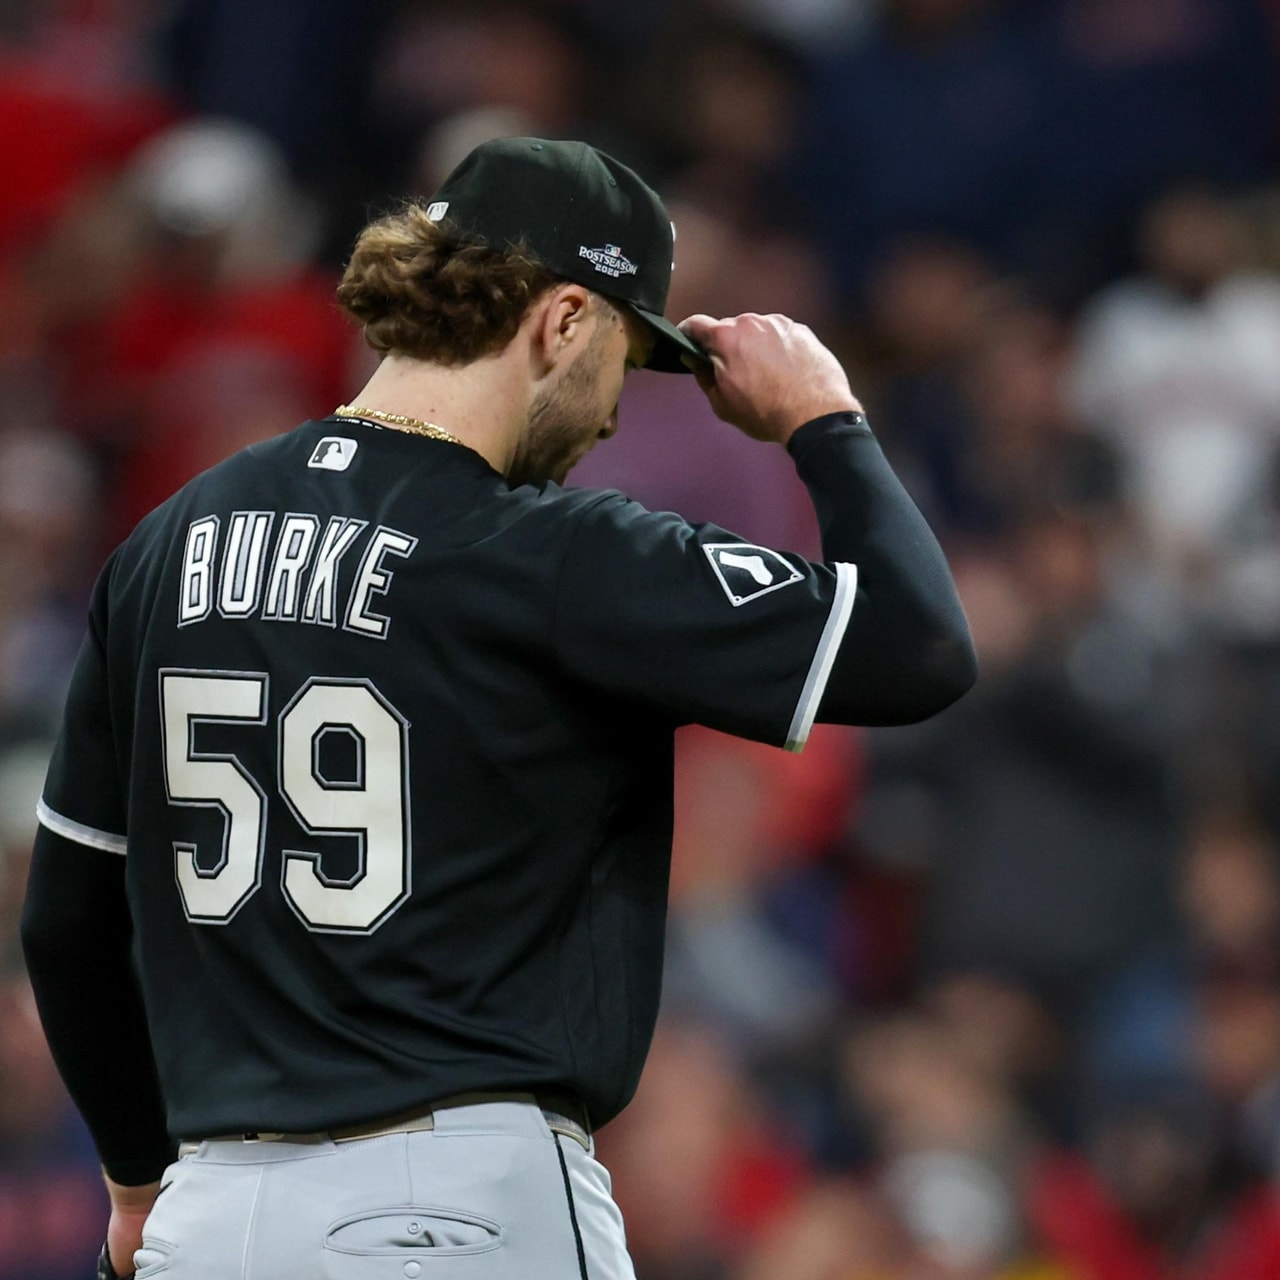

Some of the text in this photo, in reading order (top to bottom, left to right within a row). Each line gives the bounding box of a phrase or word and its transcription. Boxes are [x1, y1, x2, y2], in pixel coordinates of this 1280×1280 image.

[578, 245, 638, 276] POSTSEASON
[176, 511, 419, 640] BURKE
[158, 667, 413, 936] 59
